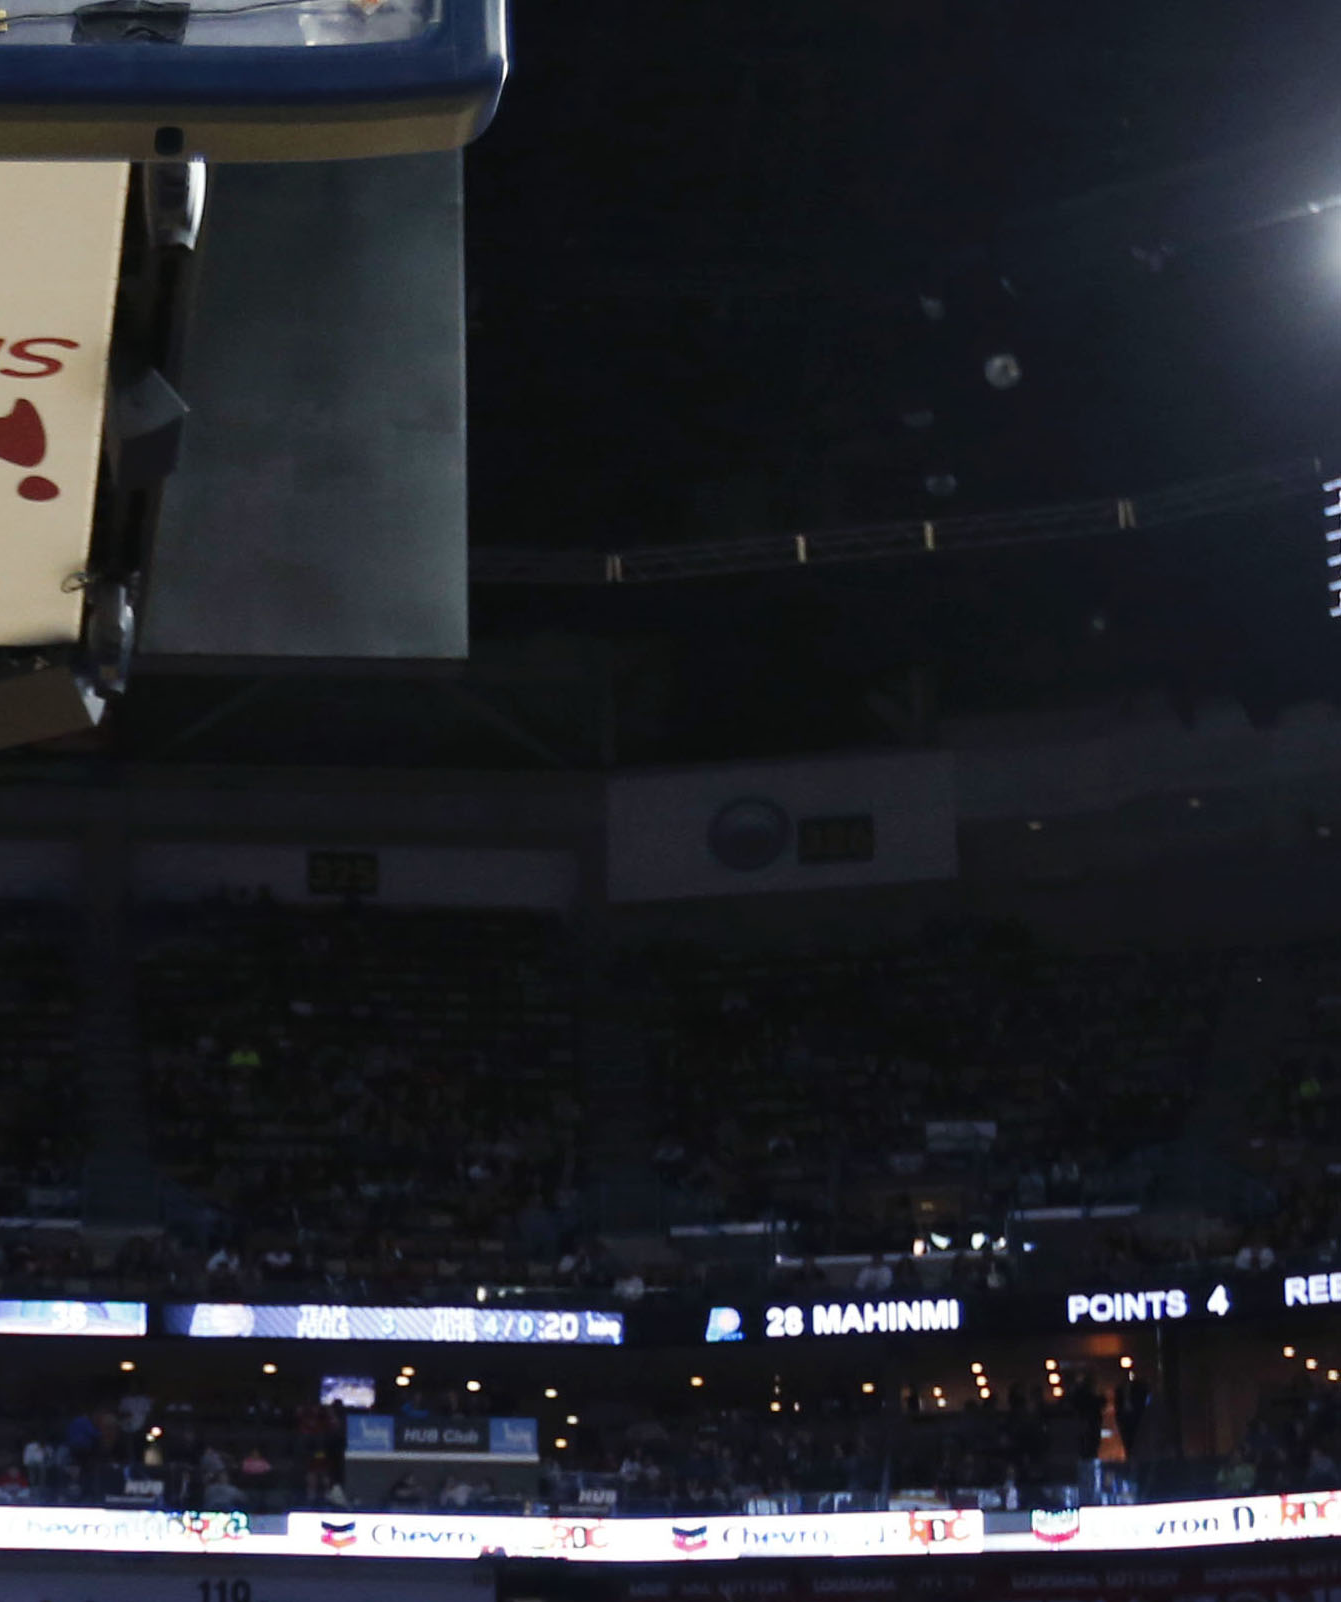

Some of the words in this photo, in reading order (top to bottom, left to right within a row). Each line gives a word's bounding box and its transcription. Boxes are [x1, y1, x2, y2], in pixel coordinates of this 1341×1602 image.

[765, 1305, 804, 1338] 28
[812, 1298, 960, 1336] MAHINMI
[1067, 1290, 1187, 1323] POINTS
[1207, 1284, 1231, 1316] 4
